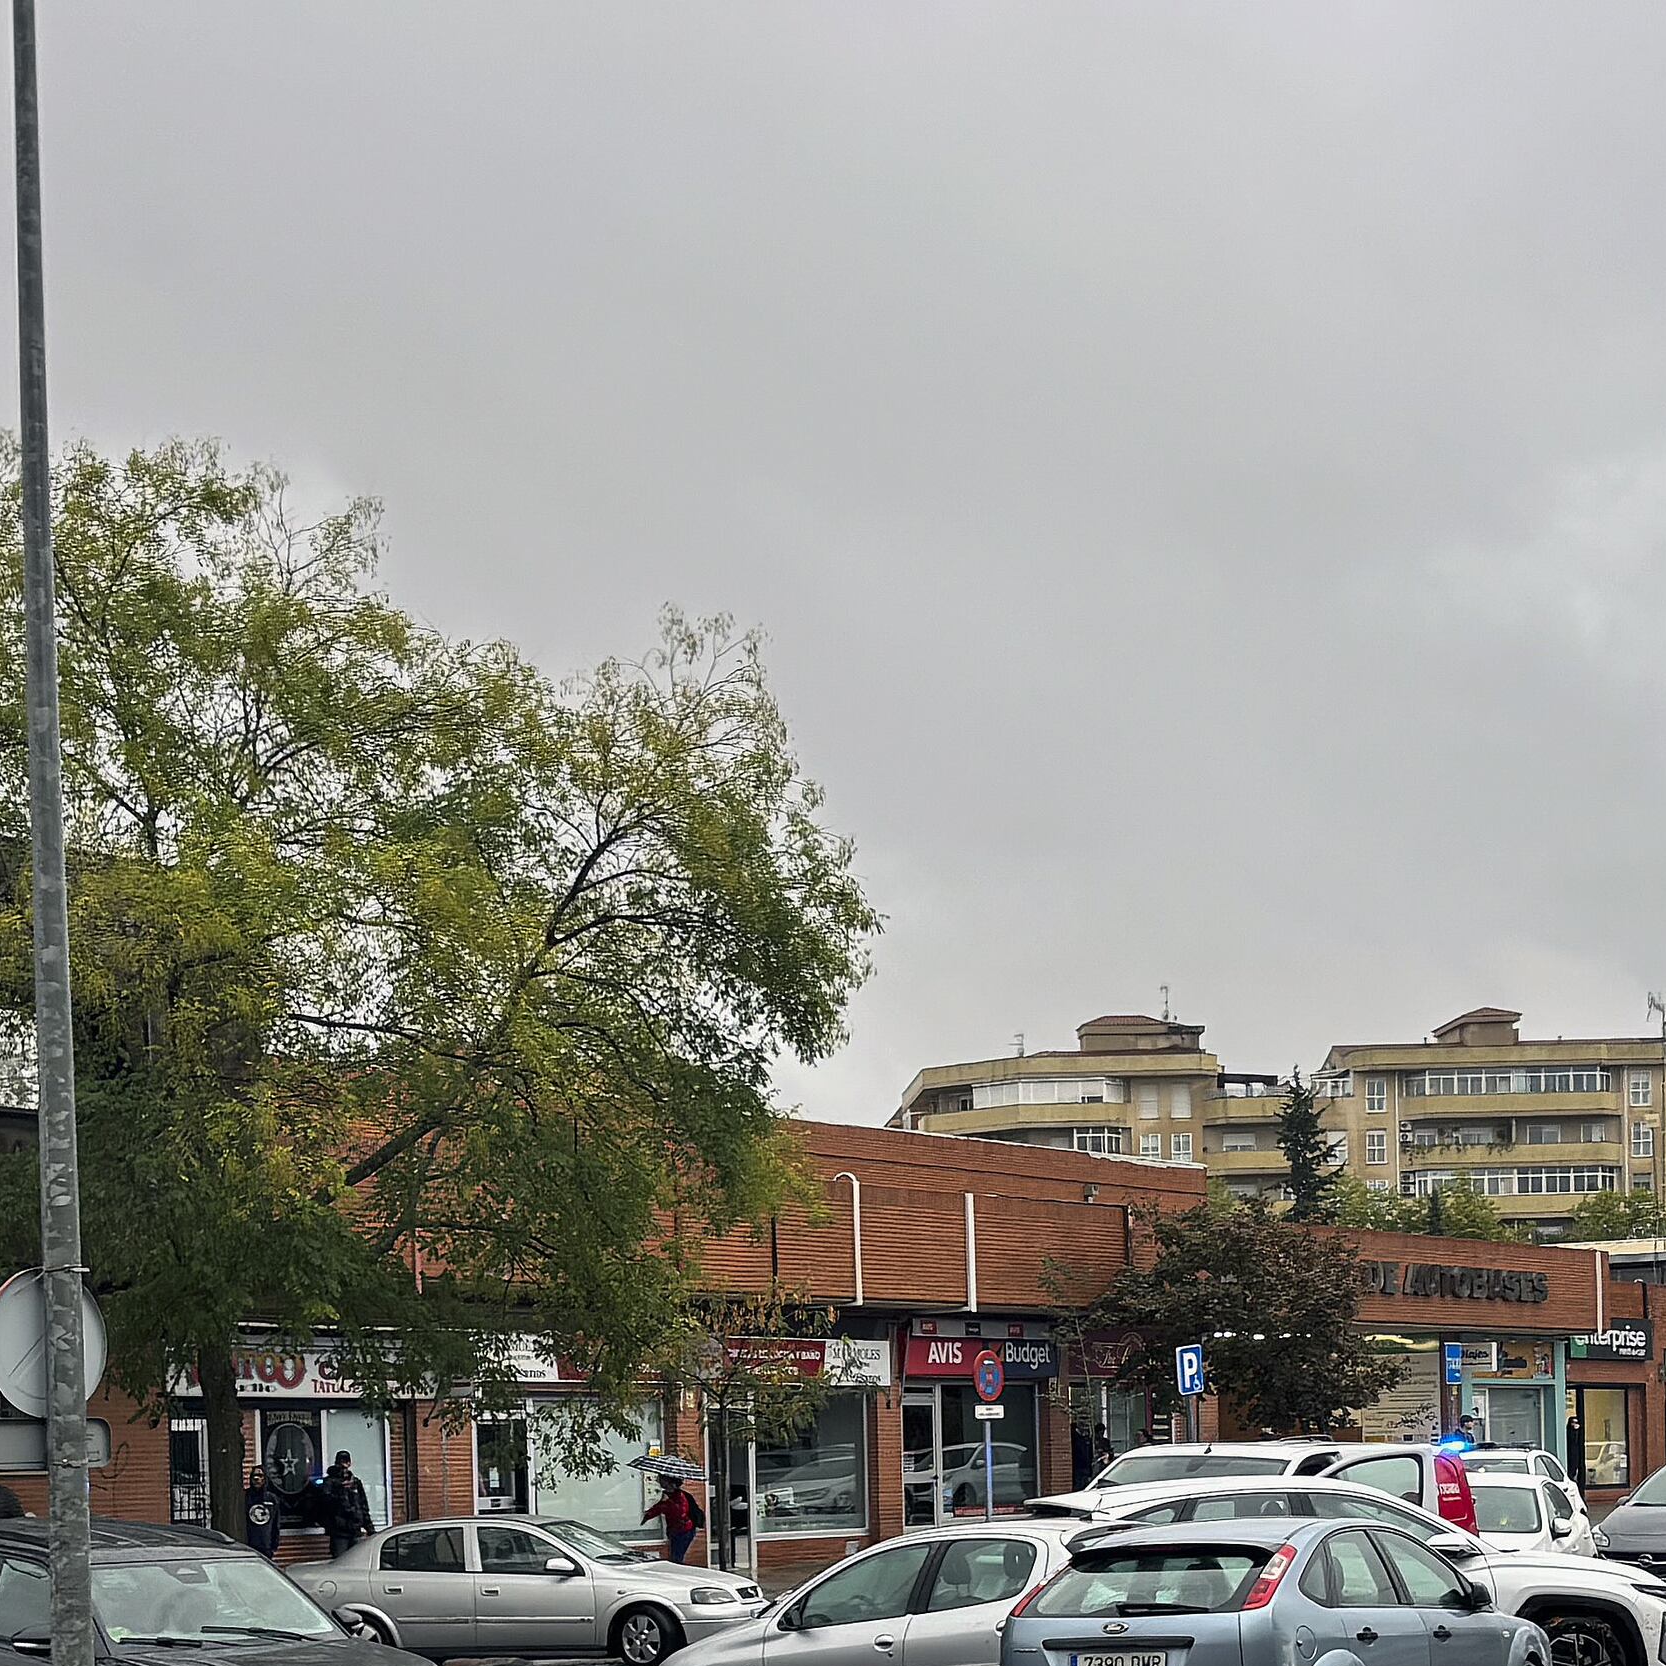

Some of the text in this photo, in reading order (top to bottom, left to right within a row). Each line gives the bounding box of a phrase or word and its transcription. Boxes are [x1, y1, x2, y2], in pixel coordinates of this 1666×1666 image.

[1403, 1264, 1549, 1303] AUTOBUSES
[927, 1341, 1051, 1370] AVIS Budget
[1182, 1352, 1198, 1389] P
